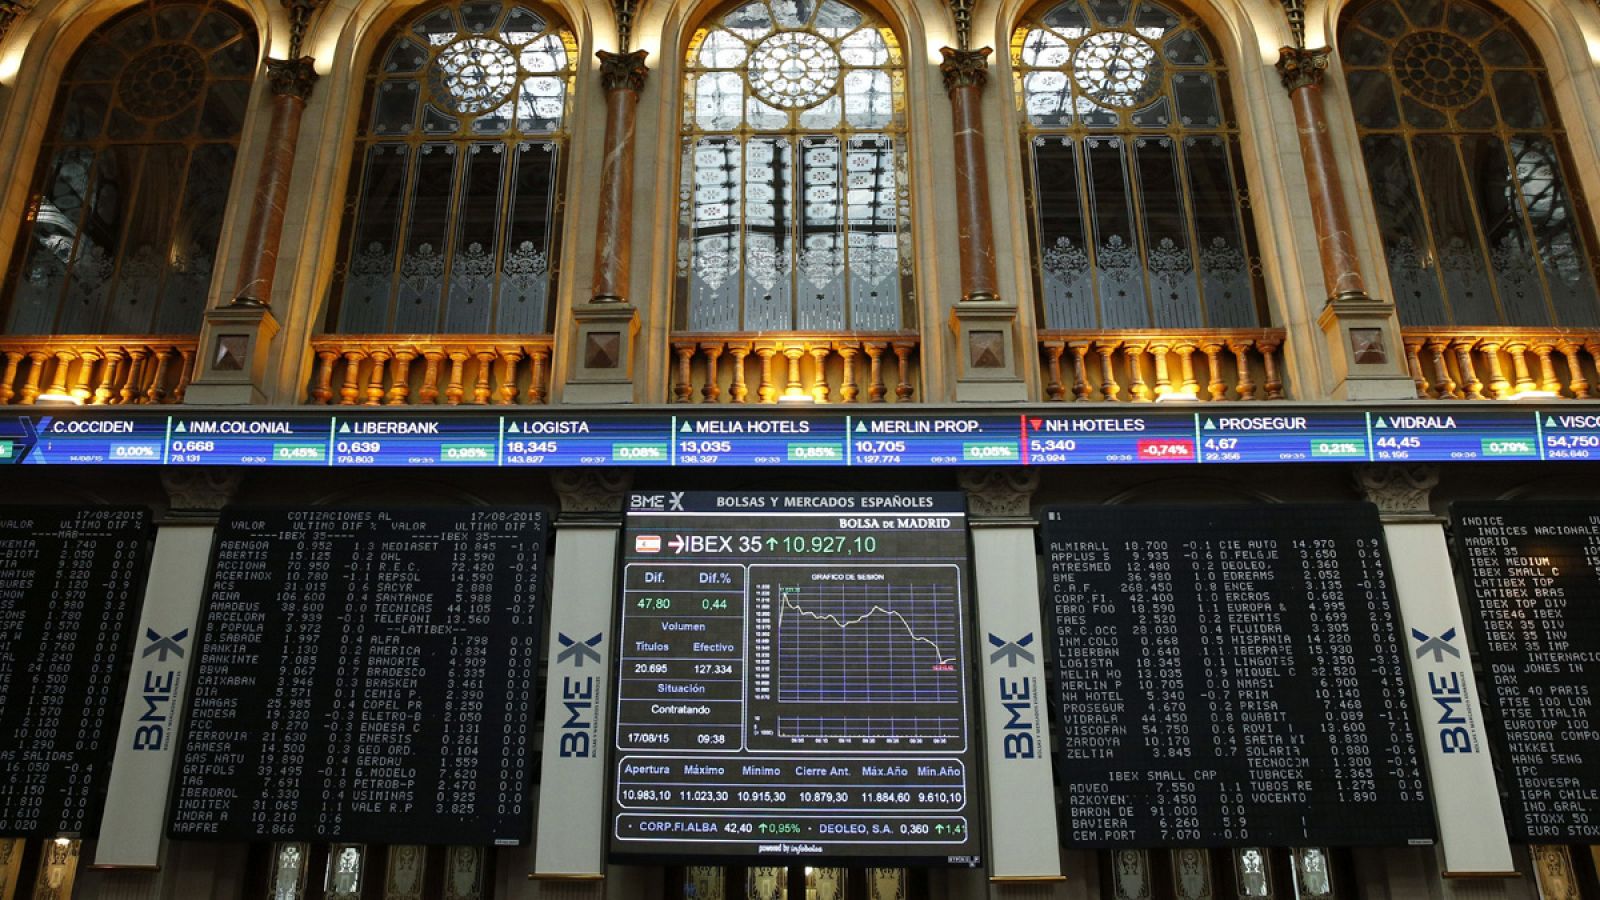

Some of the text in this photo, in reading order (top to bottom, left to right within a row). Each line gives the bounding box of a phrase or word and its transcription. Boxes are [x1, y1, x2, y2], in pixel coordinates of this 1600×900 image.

[190, 421, 292, 434] INM.COLONIAL
[354, 421, 438, 434] LIBERBANK
[524, 421, 589, 434] LOGISTA
[696, 420, 809, 433] MELIA HOTELS
[871, 420, 982, 433] MERLIN PROP.
[1046, 420, 1144, 432] NH HOTELES
[1219, 418, 1306, 430] PROSEGUR
[1389, 416, 1456, 429] VIDRALA
[173, 441, 214, 452] 0,668
[338, 441, 381, 453] 0,639
[507, 441, 556, 454] 18,345
[680, 440, 731, 453] 13,035
[855, 440, 905, 453] 10,705
[1031, 440, 1076, 452] 5,340
[1204, 438, 1237, 451] 4,67
[1376, 436, 1421, 450] 44,45
[1547, 436, 1599, 449] 54,750
[116, 447, 153, 458] 0,00%
[1143, 445, 1188, 456] -0,74%
[172, 455, 200, 463] 78.131
[630, 494, 664, 508] BME
[717, 493, 933, 508] BOLSAS Y MERCADOS ESPAÑOLES
[288, 512, 372, 521] COTIZACIONES
[471, 512, 542, 522] 17/08/2015
[1462, 517, 1504, 526] INDICE
[60, 520, 101, 529] ULTIMO
[231, 521, 266, 530] VALOR
[293, 521, 335, 531] ULTIMO
[391, 522, 426, 531] VALOR
[455, 522, 498, 531] ULTIMO
[839, 518, 879, 529] BOLSA
[897, 518, 950, 529] MADRID
[220, 541, 270, 550] ABENGOA
[382, 542, 439, 552] MEDIASET
[685, 535, 876, 555] IBEX 35 10.927,10
[1051, 540, 1336, 552] ALMIRALL 18.700 CIE AUTO 14.970
[1464, 537, 1509, 546] MADRID
[219, 551, 268, 561] ABERTIS
[1471, 557, 1550, 567] IBEX MEDIUM
[1052, 562, 1170, 572] ATRESMED 12.480
[1472, 567, 1560, 578] IBEX SMALL C
[378, 573, 421, 582] REPSOL
[645, 571, 732, 584] Dif. Dif.%
[1053, 571, 1275, 583] BME 36.980 EDREAMS
[377, 584, 413, 593] SACYR
[1474, 578, 1554, 589] LATIBEX TOP
[375, 604, 433, 613] TECNICAS
[637, 598, 728, 611] 47,80 0,44
[374, 614, 431, 624] TELEFONI
[1056, 613, 1281, 626] FAES EZENTIS
[662, 621, 706, 631] Volumen
[203, 644, 246, 654] BANKIA
[693, 642, 734, 652] Efectivo
[1059, 648, 1120, 658] LIBERBAN
[367, 668, 426, 678] BRADESCO
[635, 663, 732, 674] 20.695 127.334
[658, 682, 705, 694] Situación
[133, 671, 174, 751] BME
[651, 704, 710, 715] Contratando
[1063, 703, 1125, 714] PROSEGUR
[1428, 671, 1473, 754] BME
[559, 676, 593, 759] BME
[999, 676, 1035, 759] BME
[1065, 715, 1118, 725] VIDRALA
[628, 733, 725, 744] 17/08/15 09:38
[1509, 743, 1556, 753] NIKKEI
[624, 764, 670, 776] Apertura
[684, 763, 725, 776] Máximo
[795, 765, 827, 777] Cierre
[830, 765, 850, 777] Ant.
[862, 765, 908, 777] Máx.Año
[1109, 770, 1217, 781] IBEX SMALL CAP
[623, 790, 962, 805] 10.983,10 11.023,30 10.915,30 10.879,30 11.884,60 9.610,10
[639, 821, 718, 833] CORP.FI.ALBA
[724, 822, 753, 835] 42,40
[768, 823, 801, 834] 0,95%
[819, 823, 869, 836] DEOLEO,
[872, 823, 894, 835] S.A.
[900, 823, 929, 836] 0,360
[759, 843, 782, 855] powered
